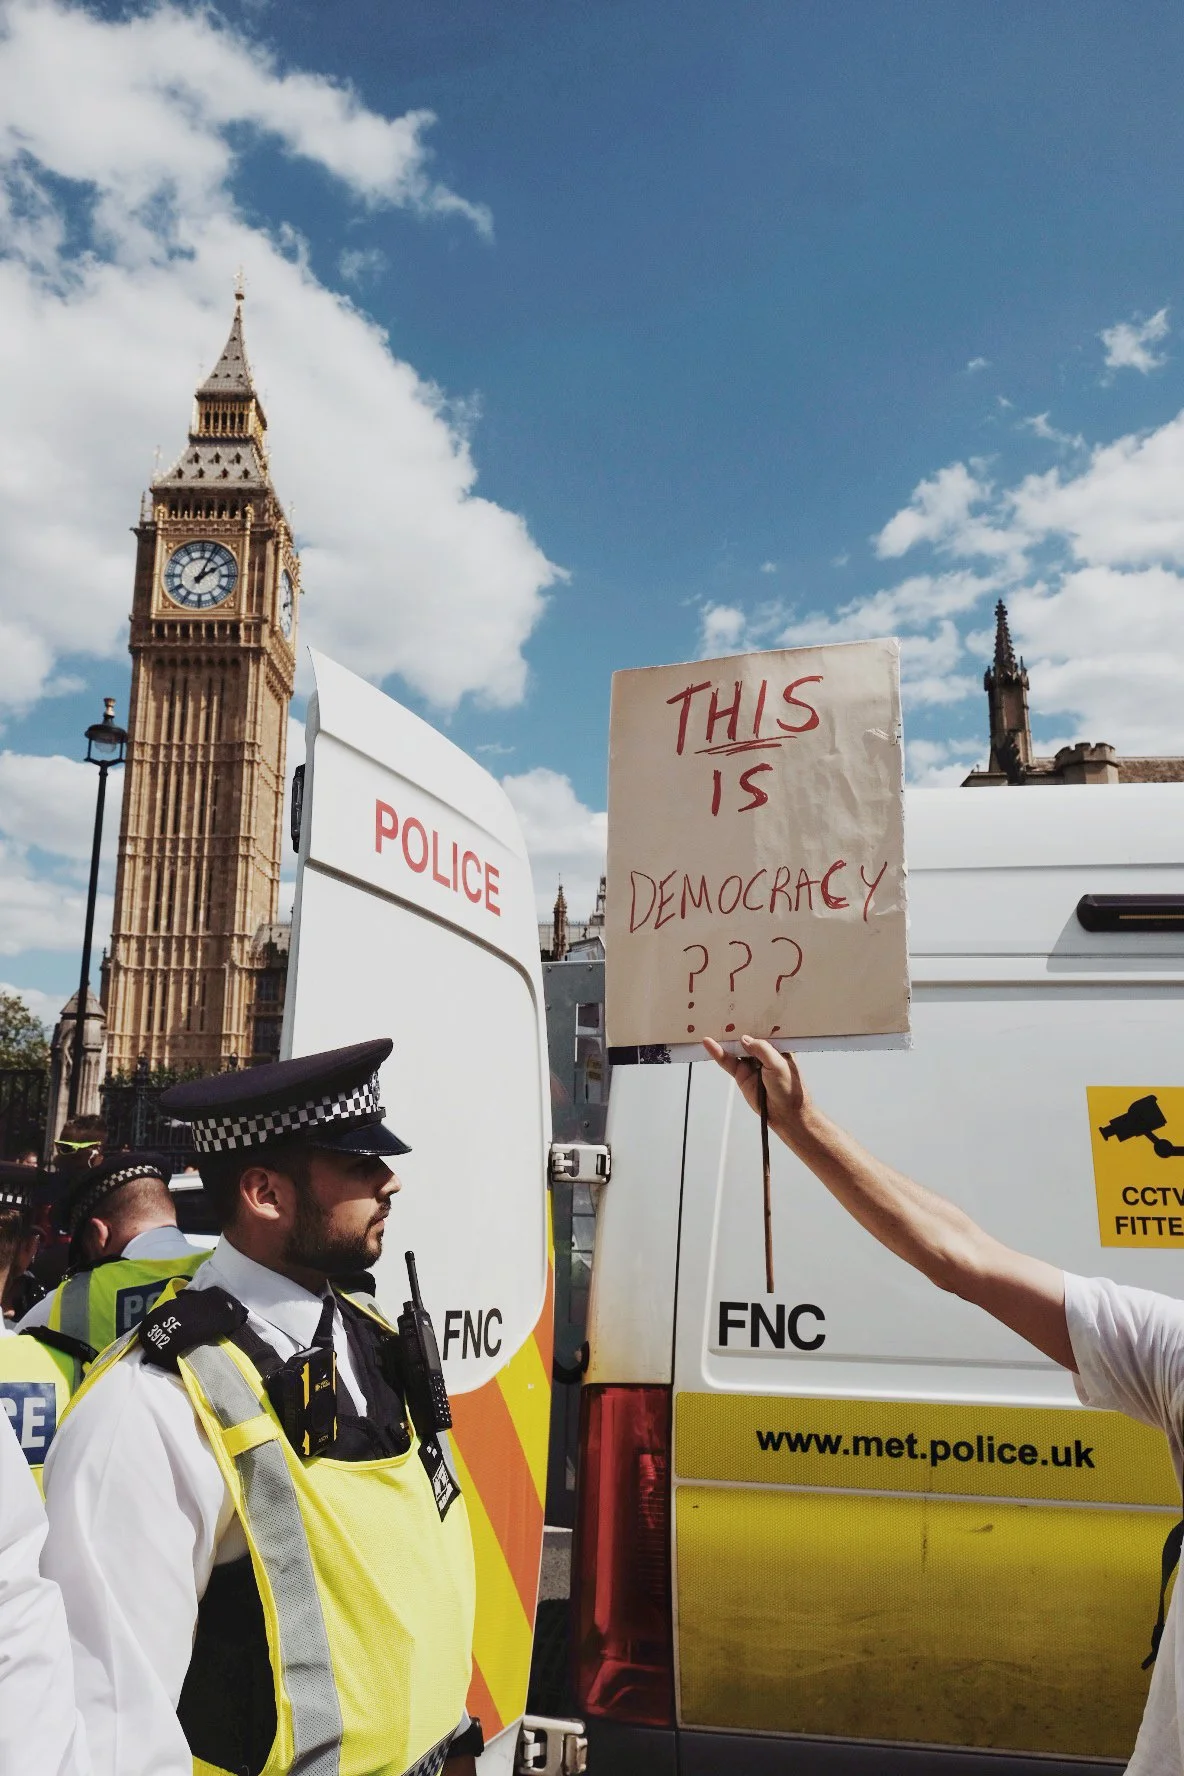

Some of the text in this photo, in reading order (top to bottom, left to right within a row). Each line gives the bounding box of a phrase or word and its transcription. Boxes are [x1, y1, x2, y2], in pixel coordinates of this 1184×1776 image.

[666, 675, 824, 755] THIS
[712, 762, 774, 816] IS
[375, 798, 501, 917] POLICE
[629, 860, 888, 933] DEMOCRACY
[147, 1324, 171, 1350] 3912
[162, 1316, 182, 1333] SE
[442, 1307, 503, 1361] FNC
[718, 1301, 826, 1351] FNC
[756, 1429, 1096, 1469] www.met.police.uk
